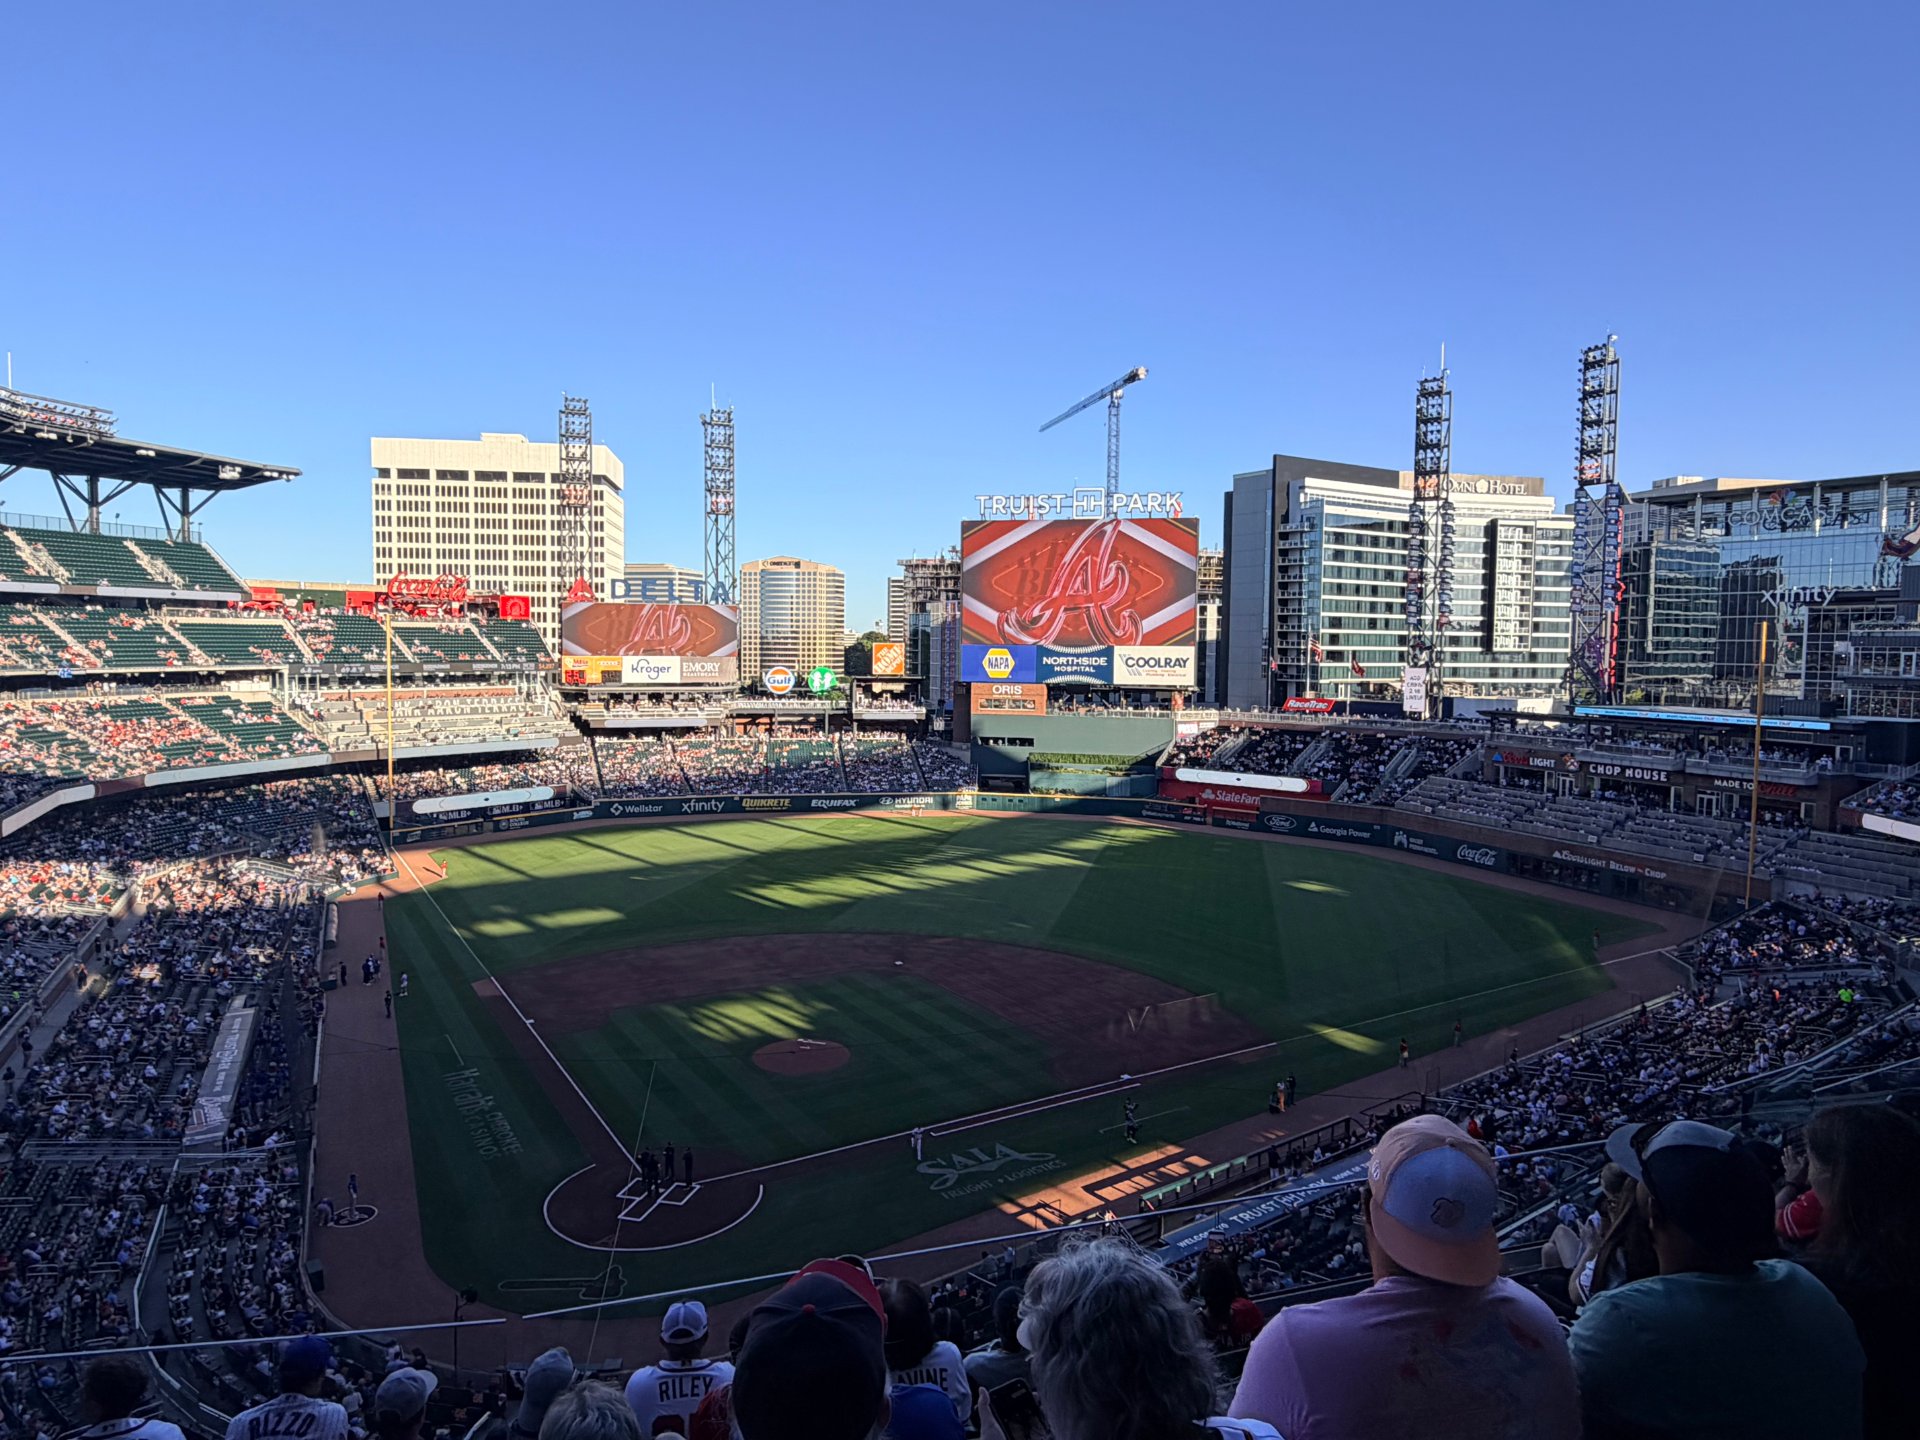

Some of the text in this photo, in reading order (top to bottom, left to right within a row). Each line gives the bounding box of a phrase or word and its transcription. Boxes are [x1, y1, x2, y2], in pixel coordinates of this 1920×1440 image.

[1443, 477, 1528, 496] OMNI HOTEL
[975, 491, 1183, 515] TRUIST PARK
[1728, 503, 1838, 527] COMCAST
[611, 578, 731, 605] DELTA
[1760, 584, 1839, 609] xfinity
[683, 662, 720, 672] EMORY
[988, 656, 1010, 669] NAPA
[1042, 657, 1108, 666] NORTHSIDE
[1125, 656, 1190, 669] COOLRAY
[631, 658, 672, 680] Kroger
[767, 676, 792, 685] Gulf
[992, 685, 1023, 695] ORIS
[1287, 699, 1328, 709] RaceTrac
[1529, 757, 1556, 768] LIGHT
[1589, 763, 1668, 782] CHOP HOUSE
[1714, 778, 1741, 788] MADE
[1742, 781, 1754, 790] TO
[625, 804, 663, 814] Wellstar
[681, 798, 725, 814] xfinity
[741, 798, 792, 807] QUIKRETE
[811, 799, 857, 809] EQUIFAX
[1269, 816, 1293, 828] Ford
[1320, 825, 1371, 838] Georgia Power
[1457, 844, 1498, 866] Coca-Cola
[1584, 856, 1607, 868] LIGHT
[1609, 860, 1636, 873] BELOW
[1645, 868, 1667, 880] CHOP
[1003, 1159, 1068, 1182] LOGISTICS
[1229, 1200, 1280, 1225] TRUIST
[1299, 1178, 1330, 1202] PARK
[659, 1375, 714, 1403] RILEY
[249, 1409, 316, 1440] RIZZO
